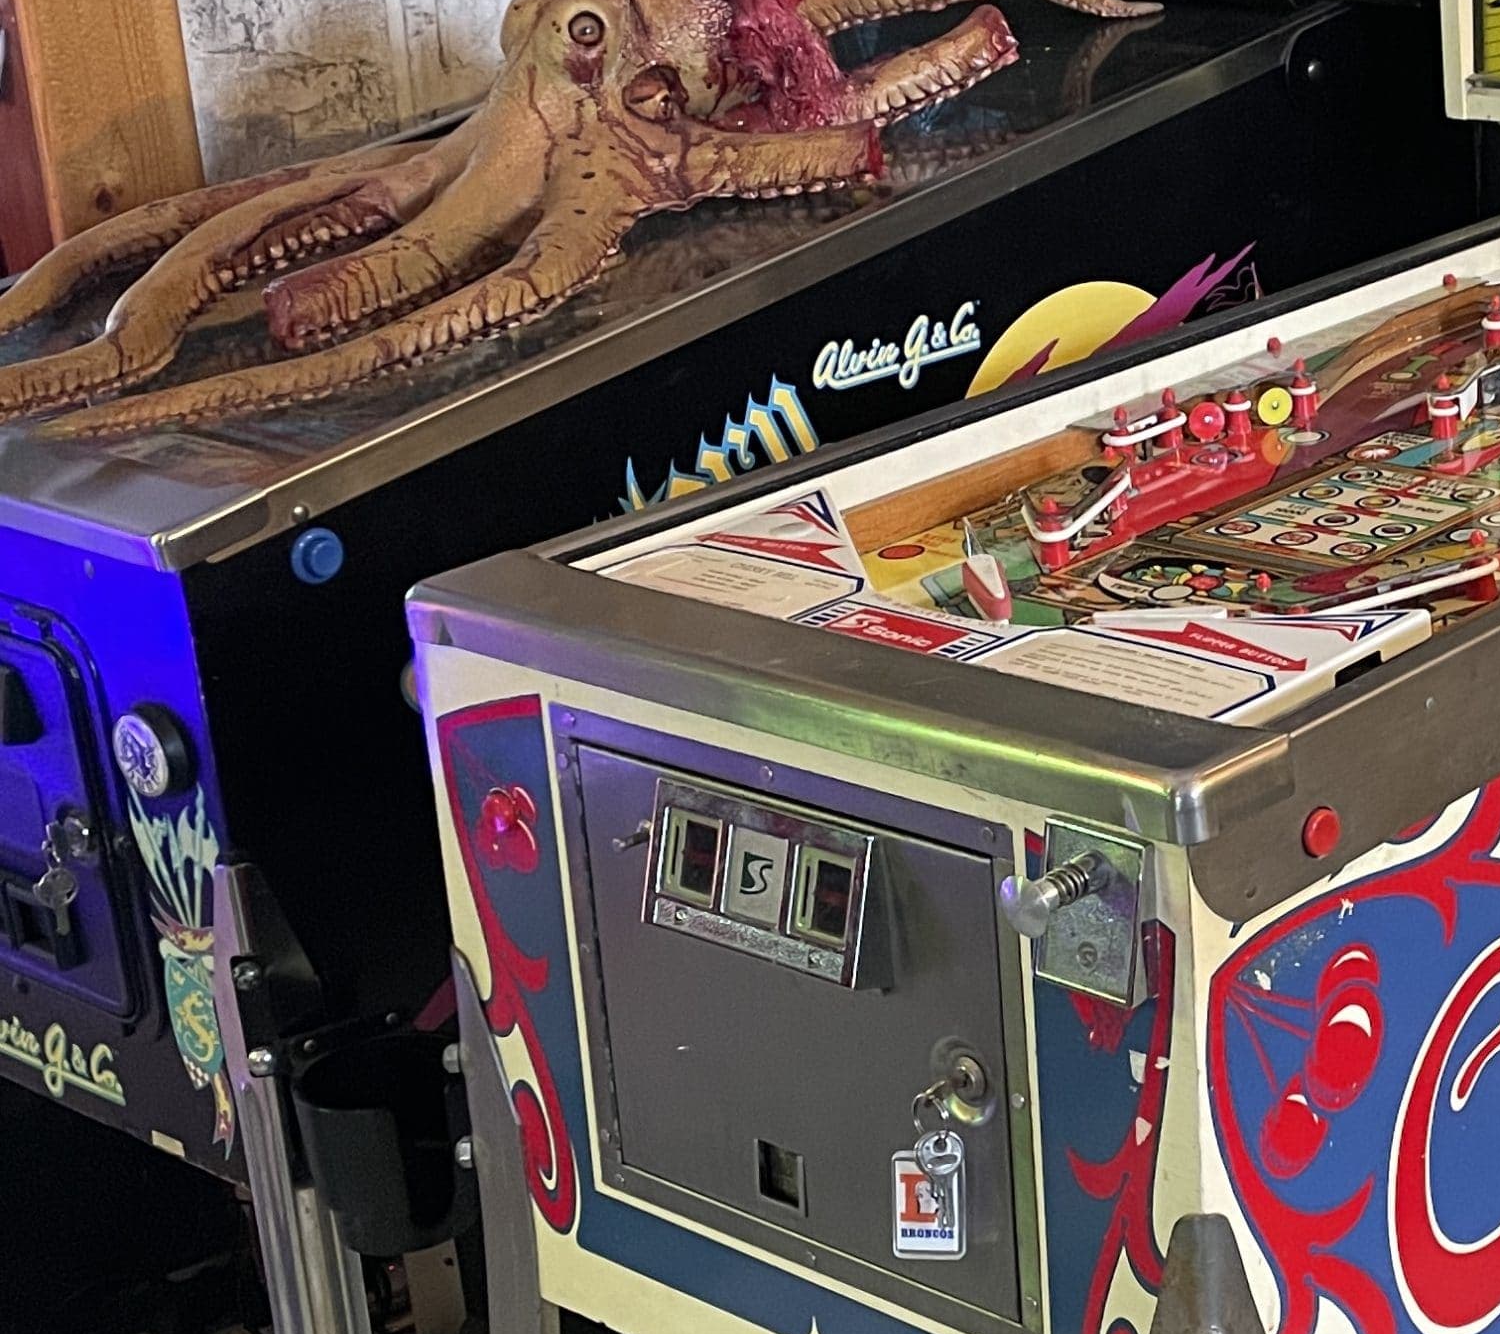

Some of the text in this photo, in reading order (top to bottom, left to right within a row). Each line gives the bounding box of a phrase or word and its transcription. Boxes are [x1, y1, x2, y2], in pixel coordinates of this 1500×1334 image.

[812, 338, 900, 389] Alvin
[931, 321, 948, 349] &
[863, 625, 934, 648] Sonic
[1238, 648, 1289, 666] BUTTON
[901, 1227, 955, 1240] BRONCOS
